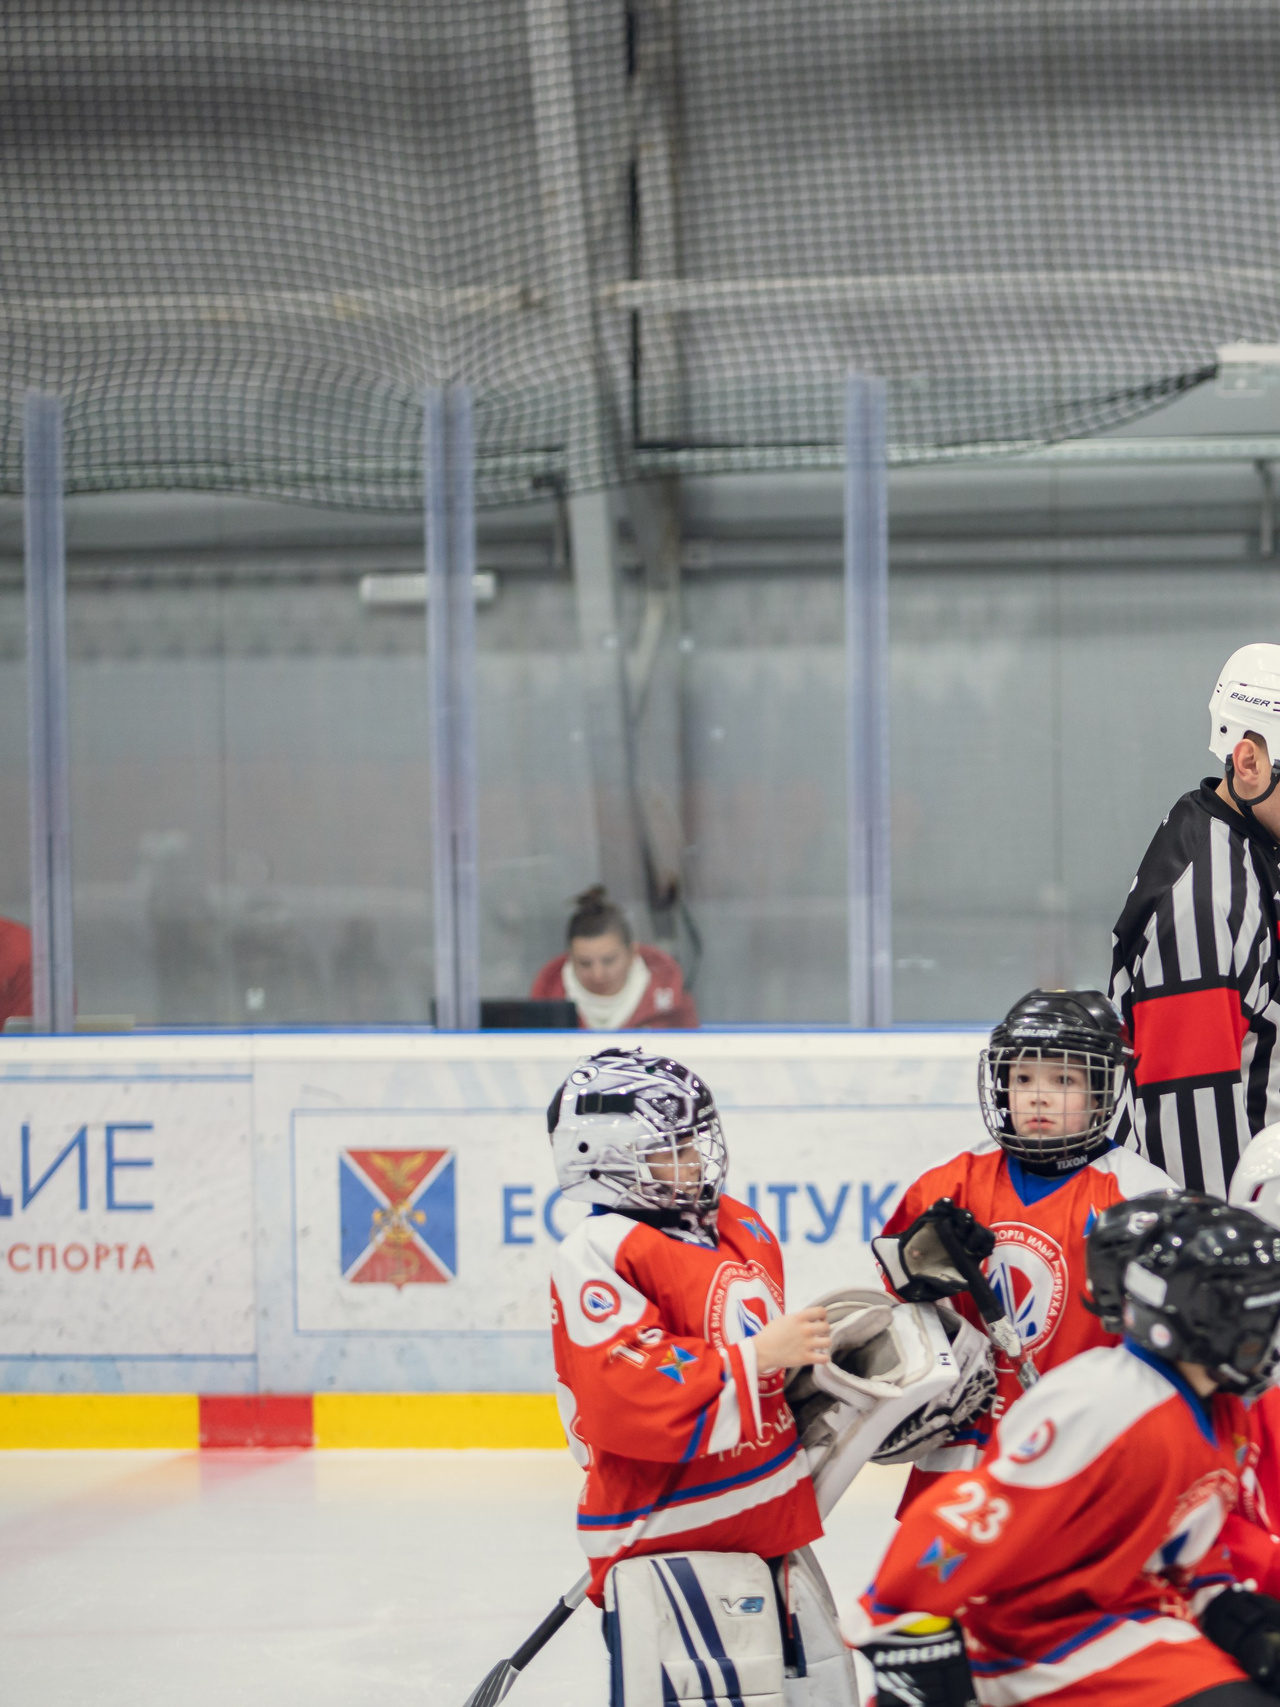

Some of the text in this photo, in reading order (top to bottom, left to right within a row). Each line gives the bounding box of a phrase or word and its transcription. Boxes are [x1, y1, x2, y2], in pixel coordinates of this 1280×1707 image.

[1230, 692, 1271, 707] BAUER
[1012, 1028, 1059, 1038] BAUER
[0, 1121, 154, 1219] ИЕ
[1056, 1155, 1088, 1170] TIXON
[7, 1242, 155, 1273] СПОРТА
[937, 1481, 1009, 1542] 23
